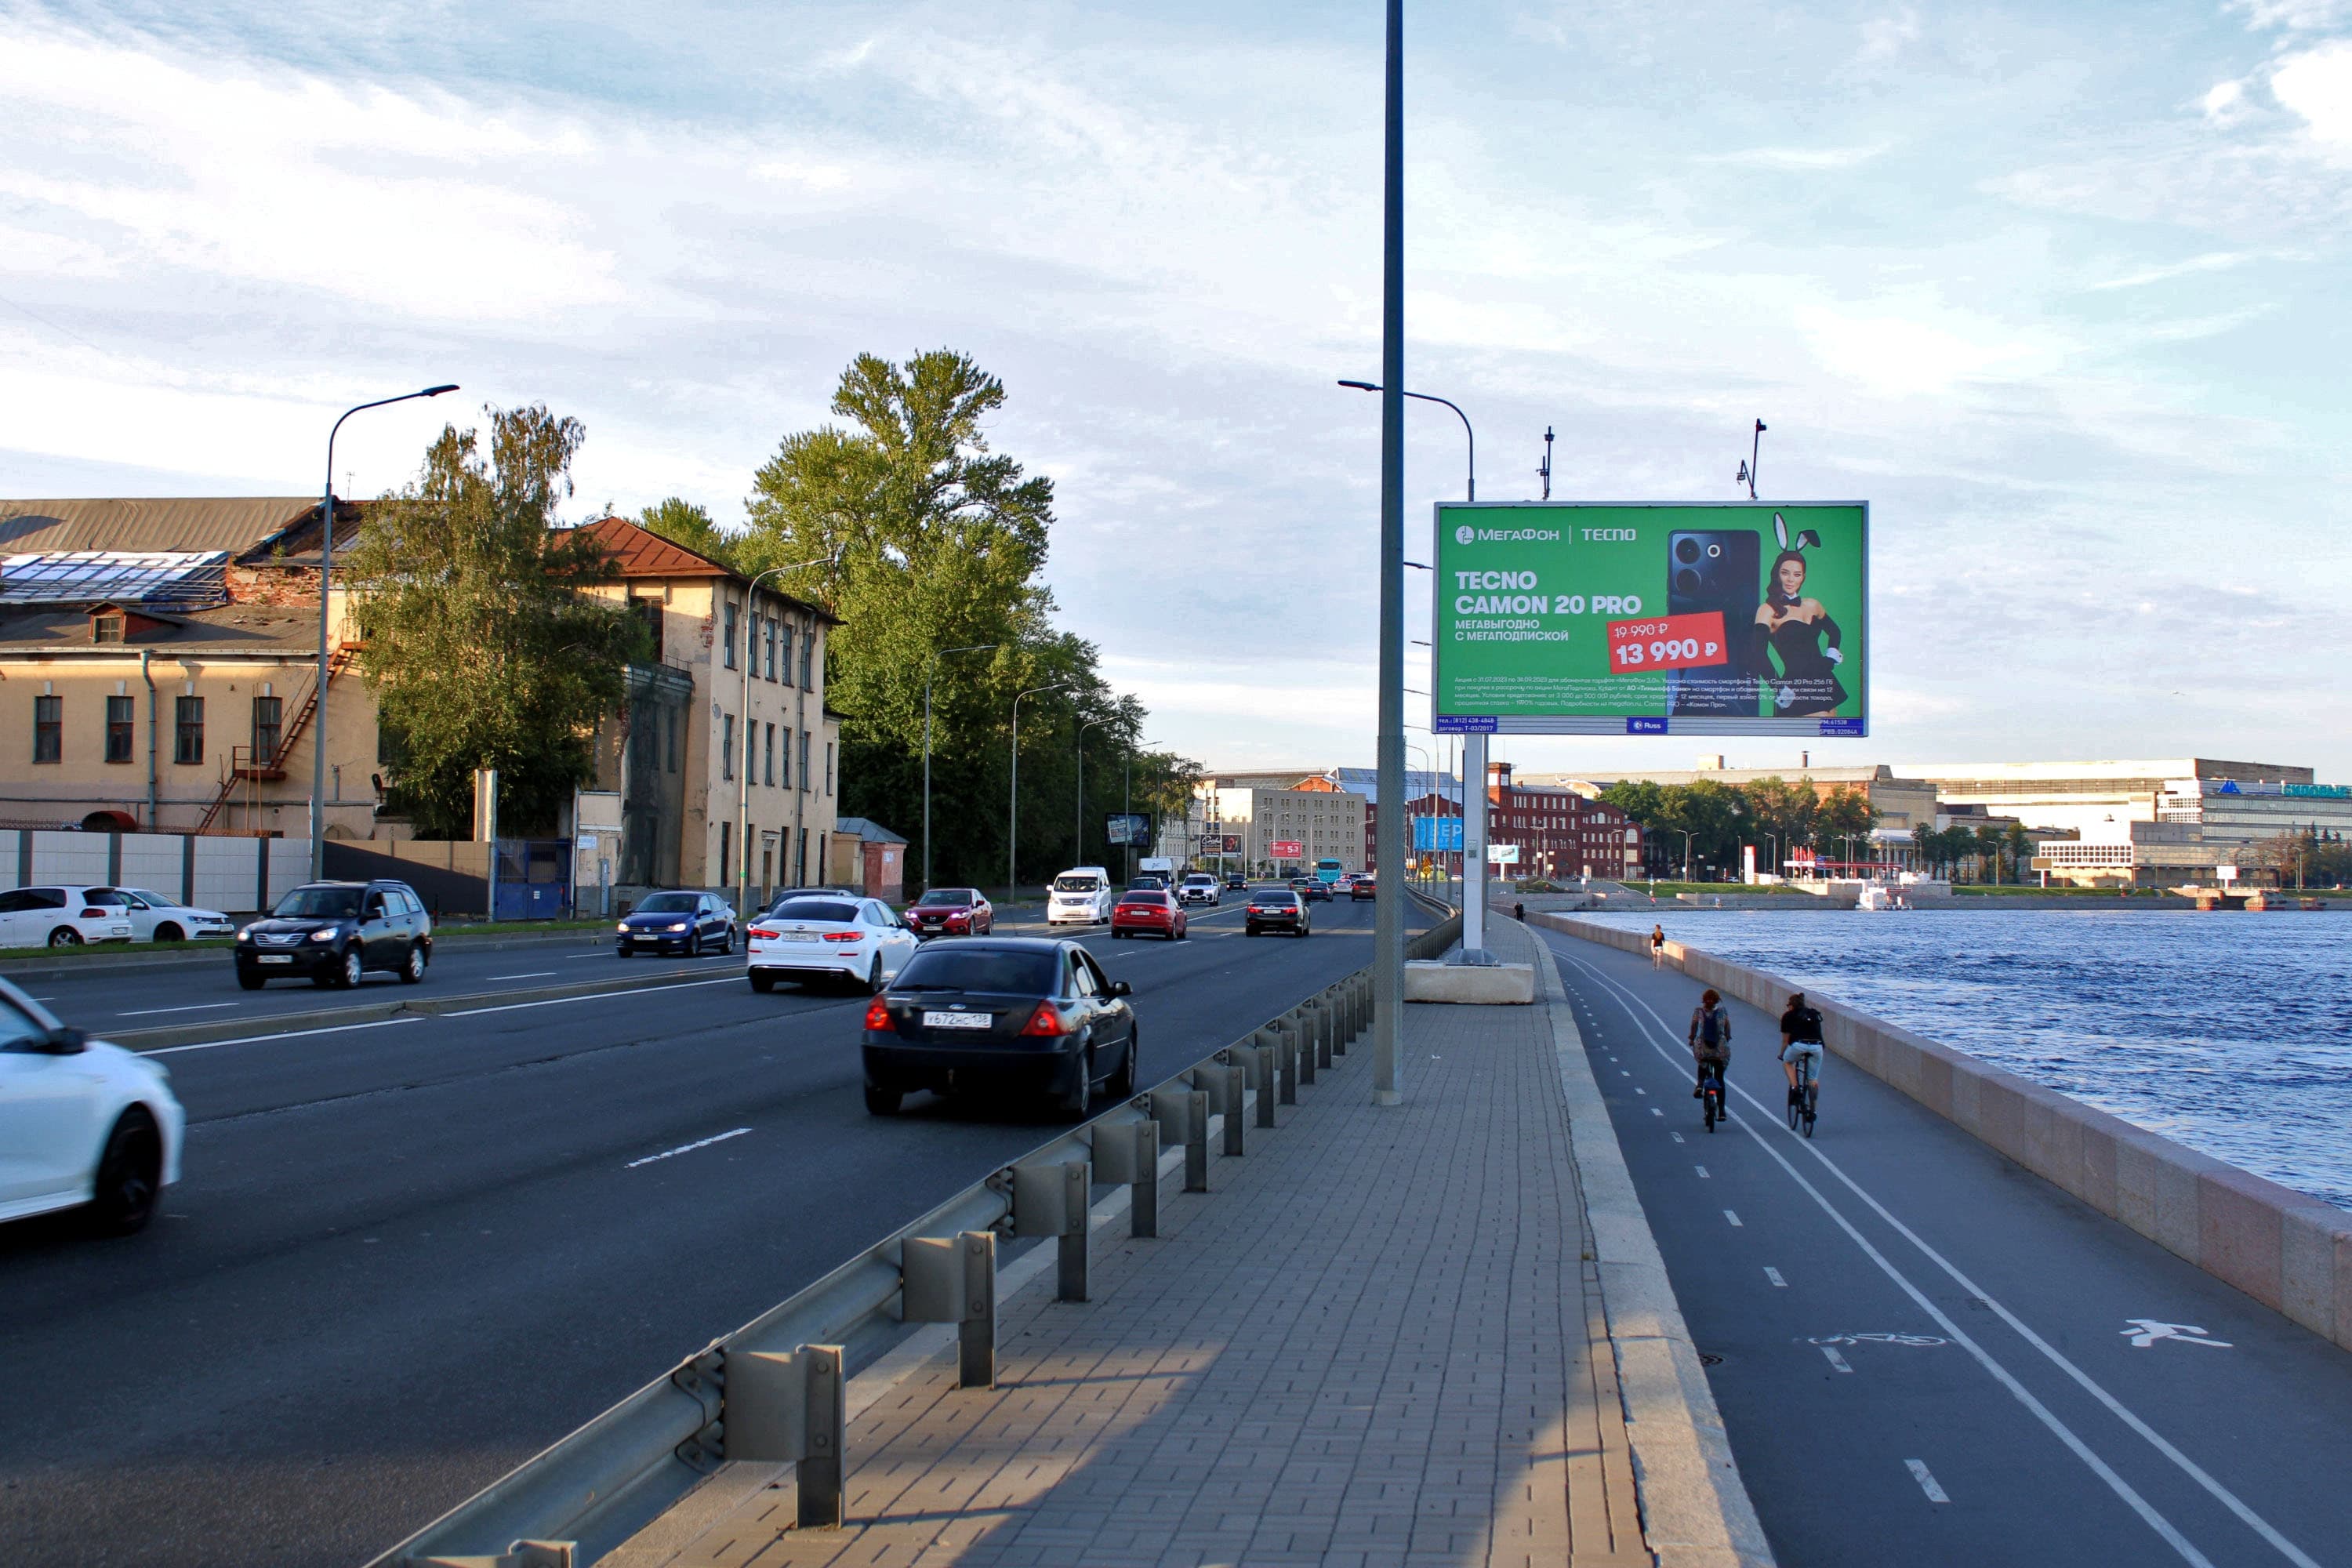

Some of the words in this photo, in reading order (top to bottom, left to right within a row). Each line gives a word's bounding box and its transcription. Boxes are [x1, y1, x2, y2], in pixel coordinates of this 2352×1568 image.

[1478, 528, 1559, 541] МегаФон
[1581, 528, 1636, 541] TECNO
[1455, 571, 1537, 590] TECNO
[1455, 595, 1548, 615] CAMON
[1555, 595, 1585, 615] 20
[1592, 595, 1642, 615] PRO
[1455, 619, 1540, 630] МЕГАВЫГОДНО
[1614, 626, 1628, 638] 19
[1631, 623, 1655, 637] 990
[1455, 631, 1464, 641] С
[1467, 630, 1568, 641] МЕГАПОДПИСКОЙ
[1617, 644, 1644, 665] 13
[1650, 638, 1699, 662] 990
